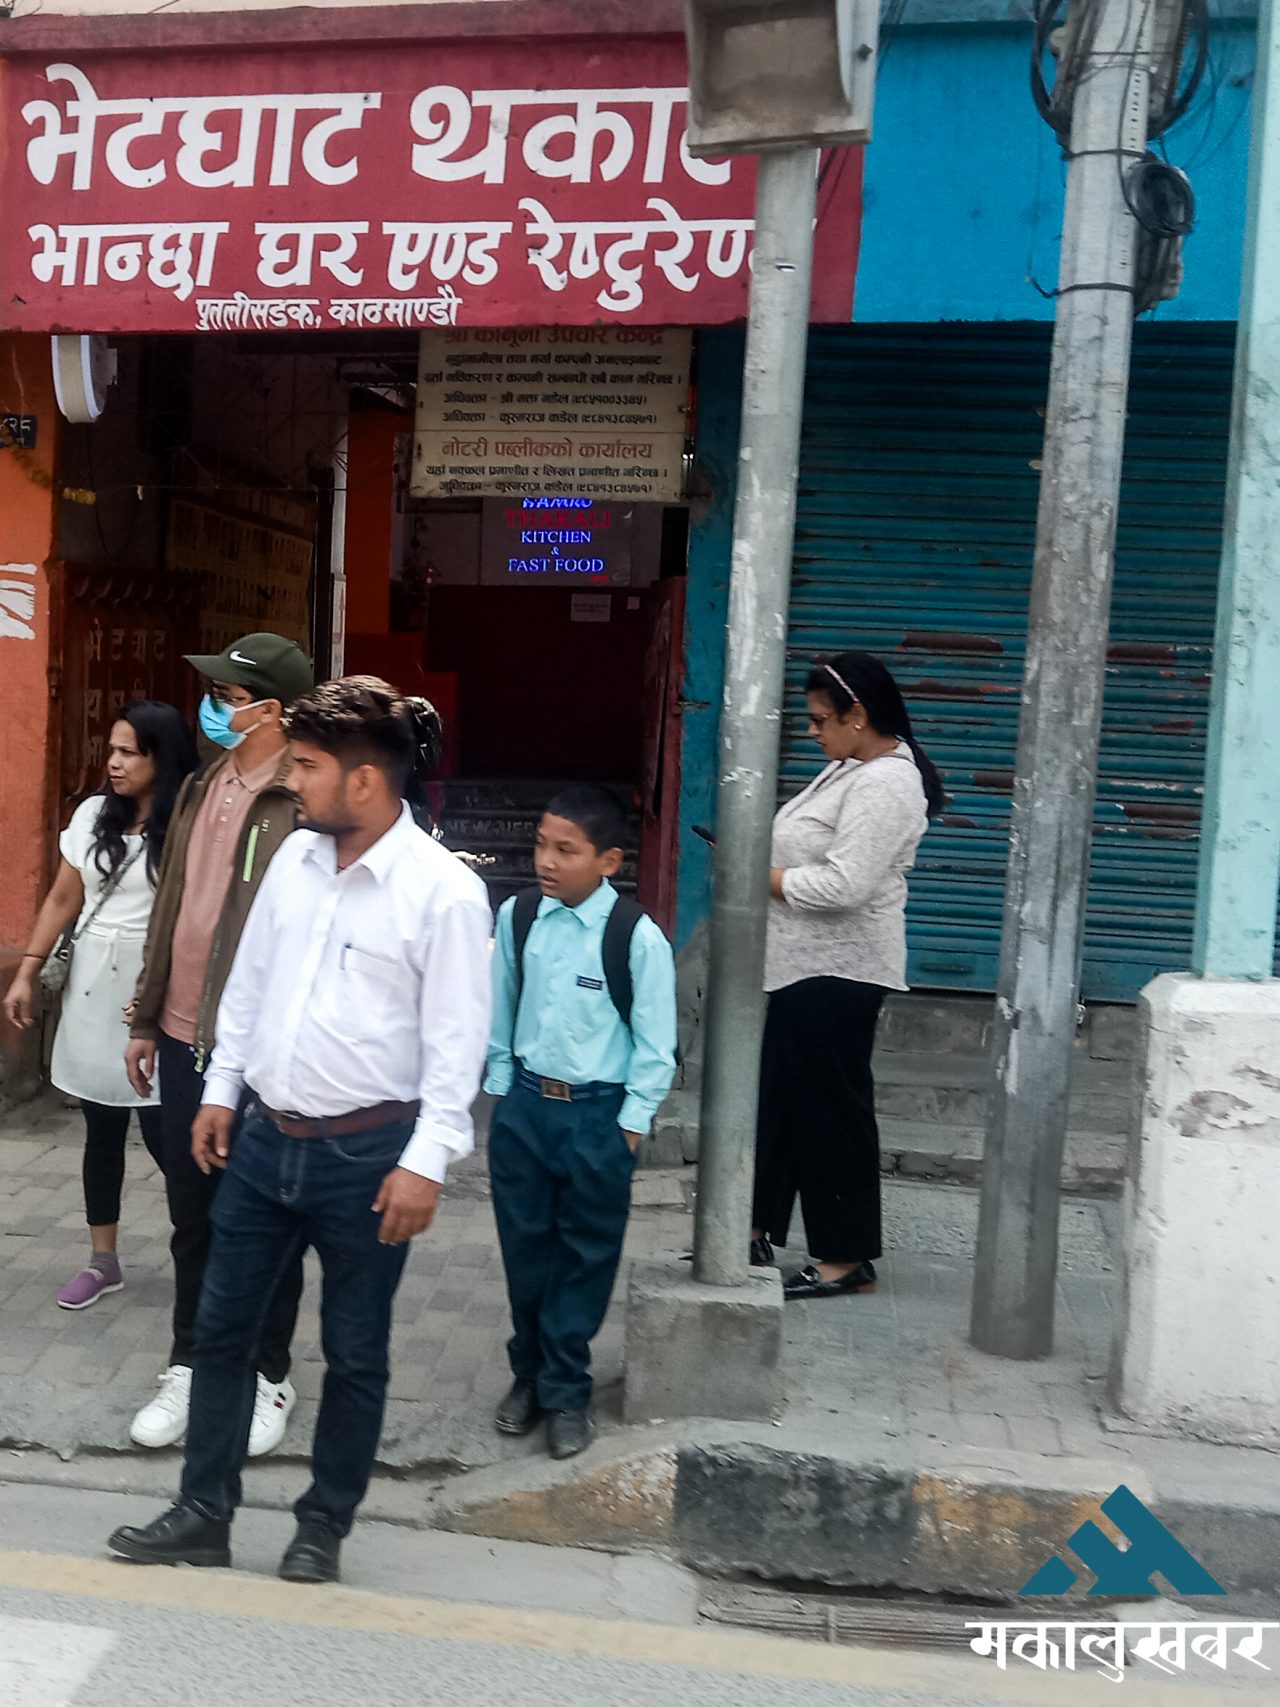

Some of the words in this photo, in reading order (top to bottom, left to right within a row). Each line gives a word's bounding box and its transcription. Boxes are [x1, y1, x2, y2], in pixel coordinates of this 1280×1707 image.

[21, 63, 382, 190] भेटघाट
[409, 85, 733, 186] थका
[28, 221, 230, 301] भान्छा
[254, 221, 370, 286] घर
[383, 221, 513, 289] एण्ड
[518, 197, 760, 312] रेष्टुरेण्
[328, 284, 463, 327] काठमाण्डौ
[615, 328, 663, 345] कन्द्र
[441, 437, 488, 457] नोटरी
[579, 439, 654, 458] कार्यालय
[521, 530, 592, 544] KITCHEN
[550, 546, 560, 556] &
[508, 558, 551, 572] FAST
[554, 558, 604, 572] FOOD
